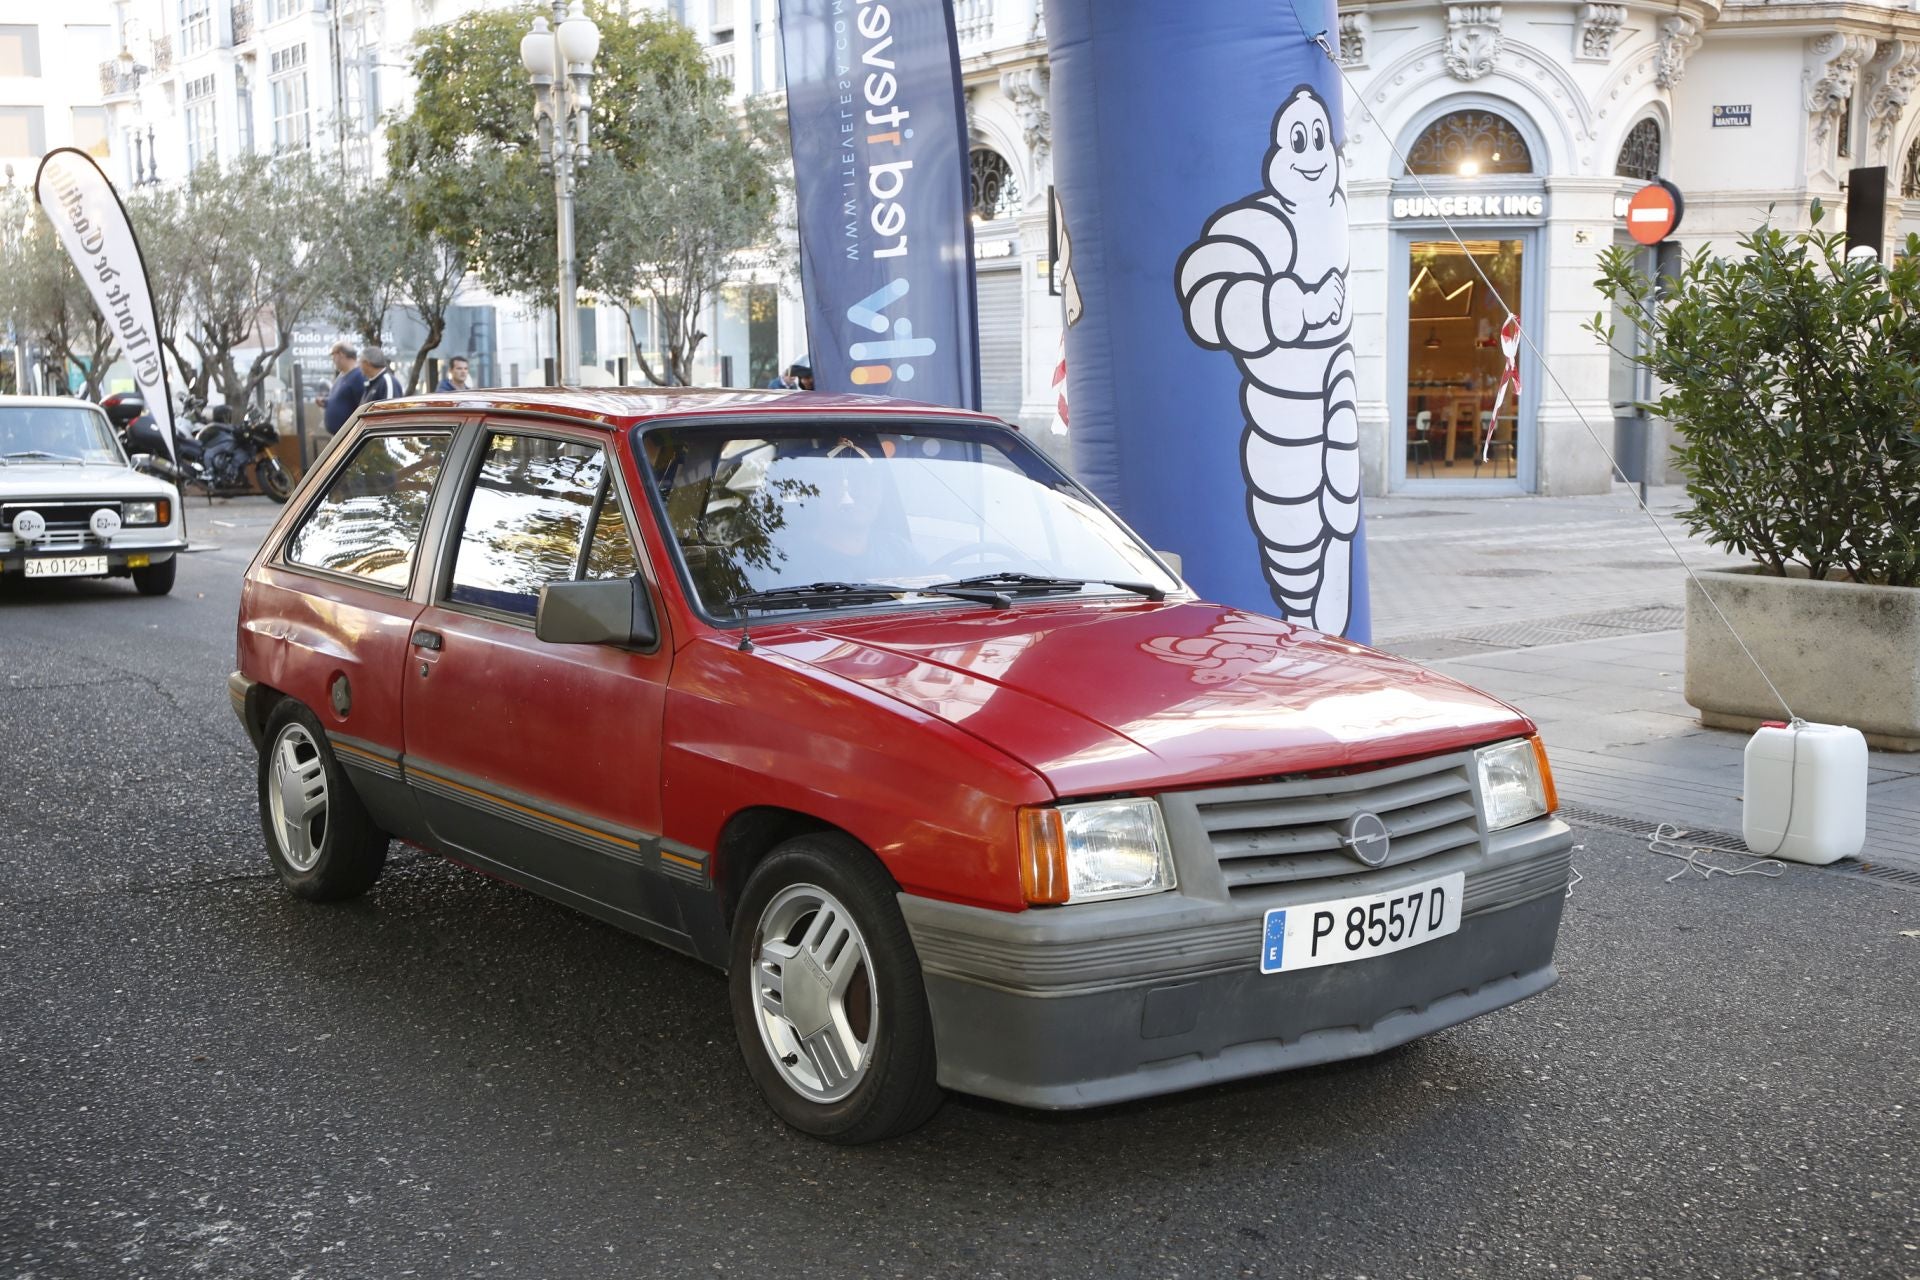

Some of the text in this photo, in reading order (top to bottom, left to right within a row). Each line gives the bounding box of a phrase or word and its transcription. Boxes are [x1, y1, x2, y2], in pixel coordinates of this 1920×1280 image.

[1726, 106, 1750, 114] CALLE
[1715, 117, 1748, 125] MANTILLA
[293, 332, 321, 342] Todo
[292, 345, 335, 356] cuand
[1311, 887, 1444, 957] P 8557 D
[1269, 947, 1277, 960] E
